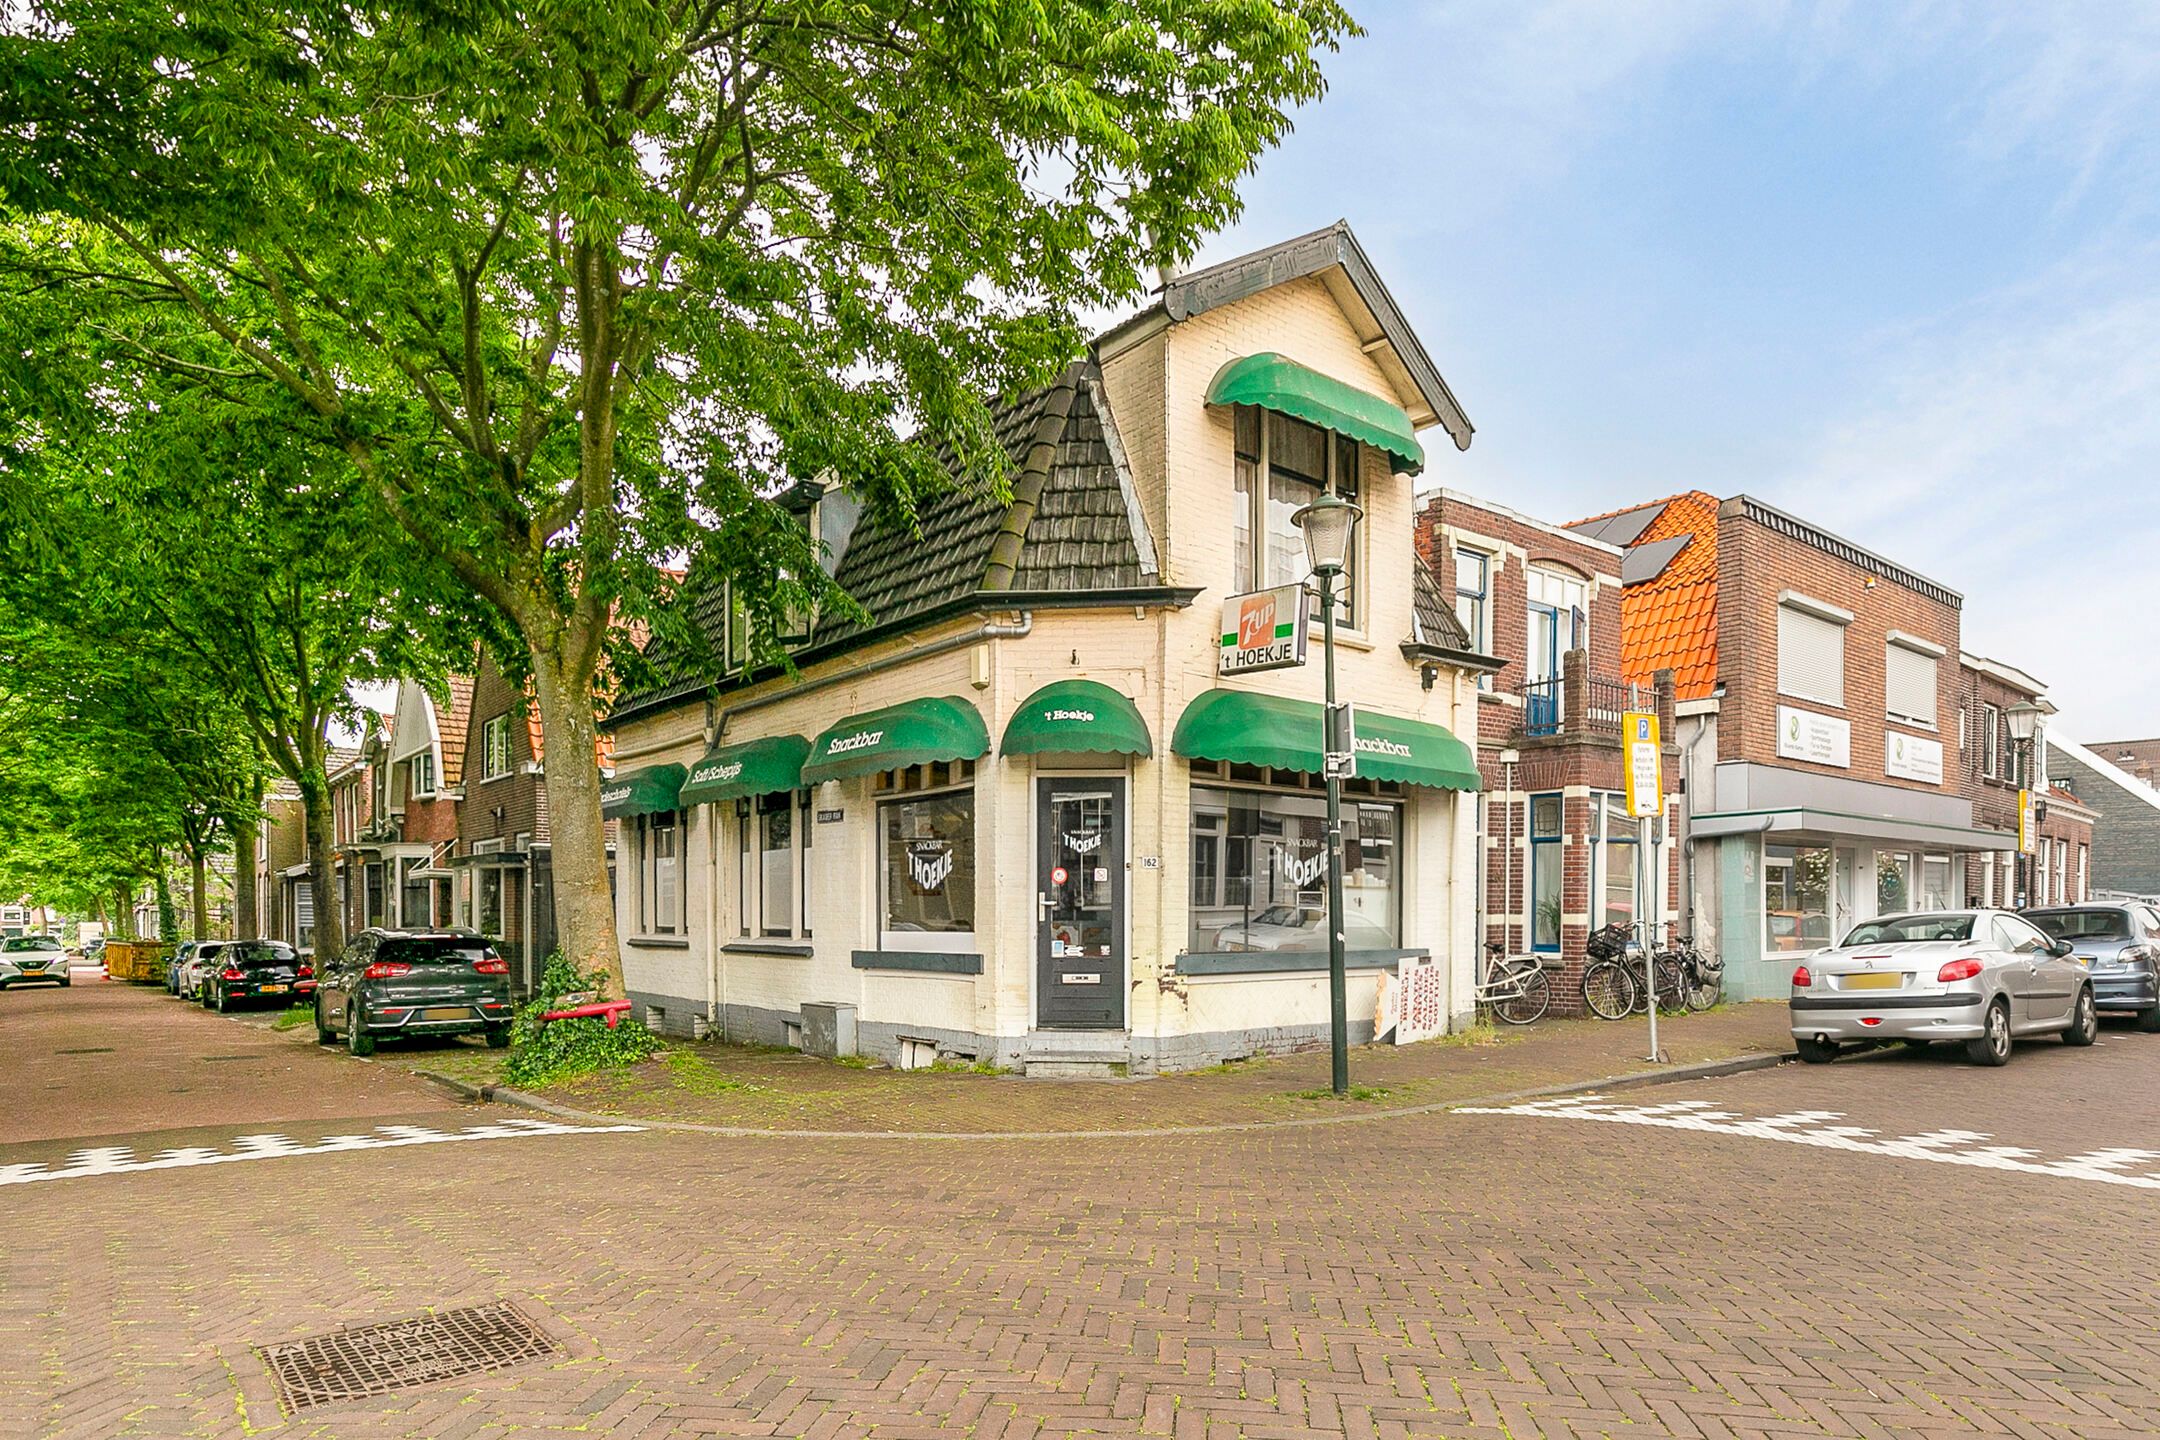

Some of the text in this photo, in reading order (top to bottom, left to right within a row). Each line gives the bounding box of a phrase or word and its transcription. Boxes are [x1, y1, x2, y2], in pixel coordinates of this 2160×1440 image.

[1236, 643, 1292, 667] HOEKJE
[1053, 710, 1094, 722] Hoekje
[827, 731, 883, 755] Snackbar
[1352, 737, 1412, 758] nackbar
[1070, 834, 1102, 853] HOEKJE
[1286, 838, 1319, 848] SNACKBAR
[914, 848, 953, 890] HOEKJE
[1143, 858, 1157, 867] 162
[1284, 848, 1329, 887] HOEKJE
